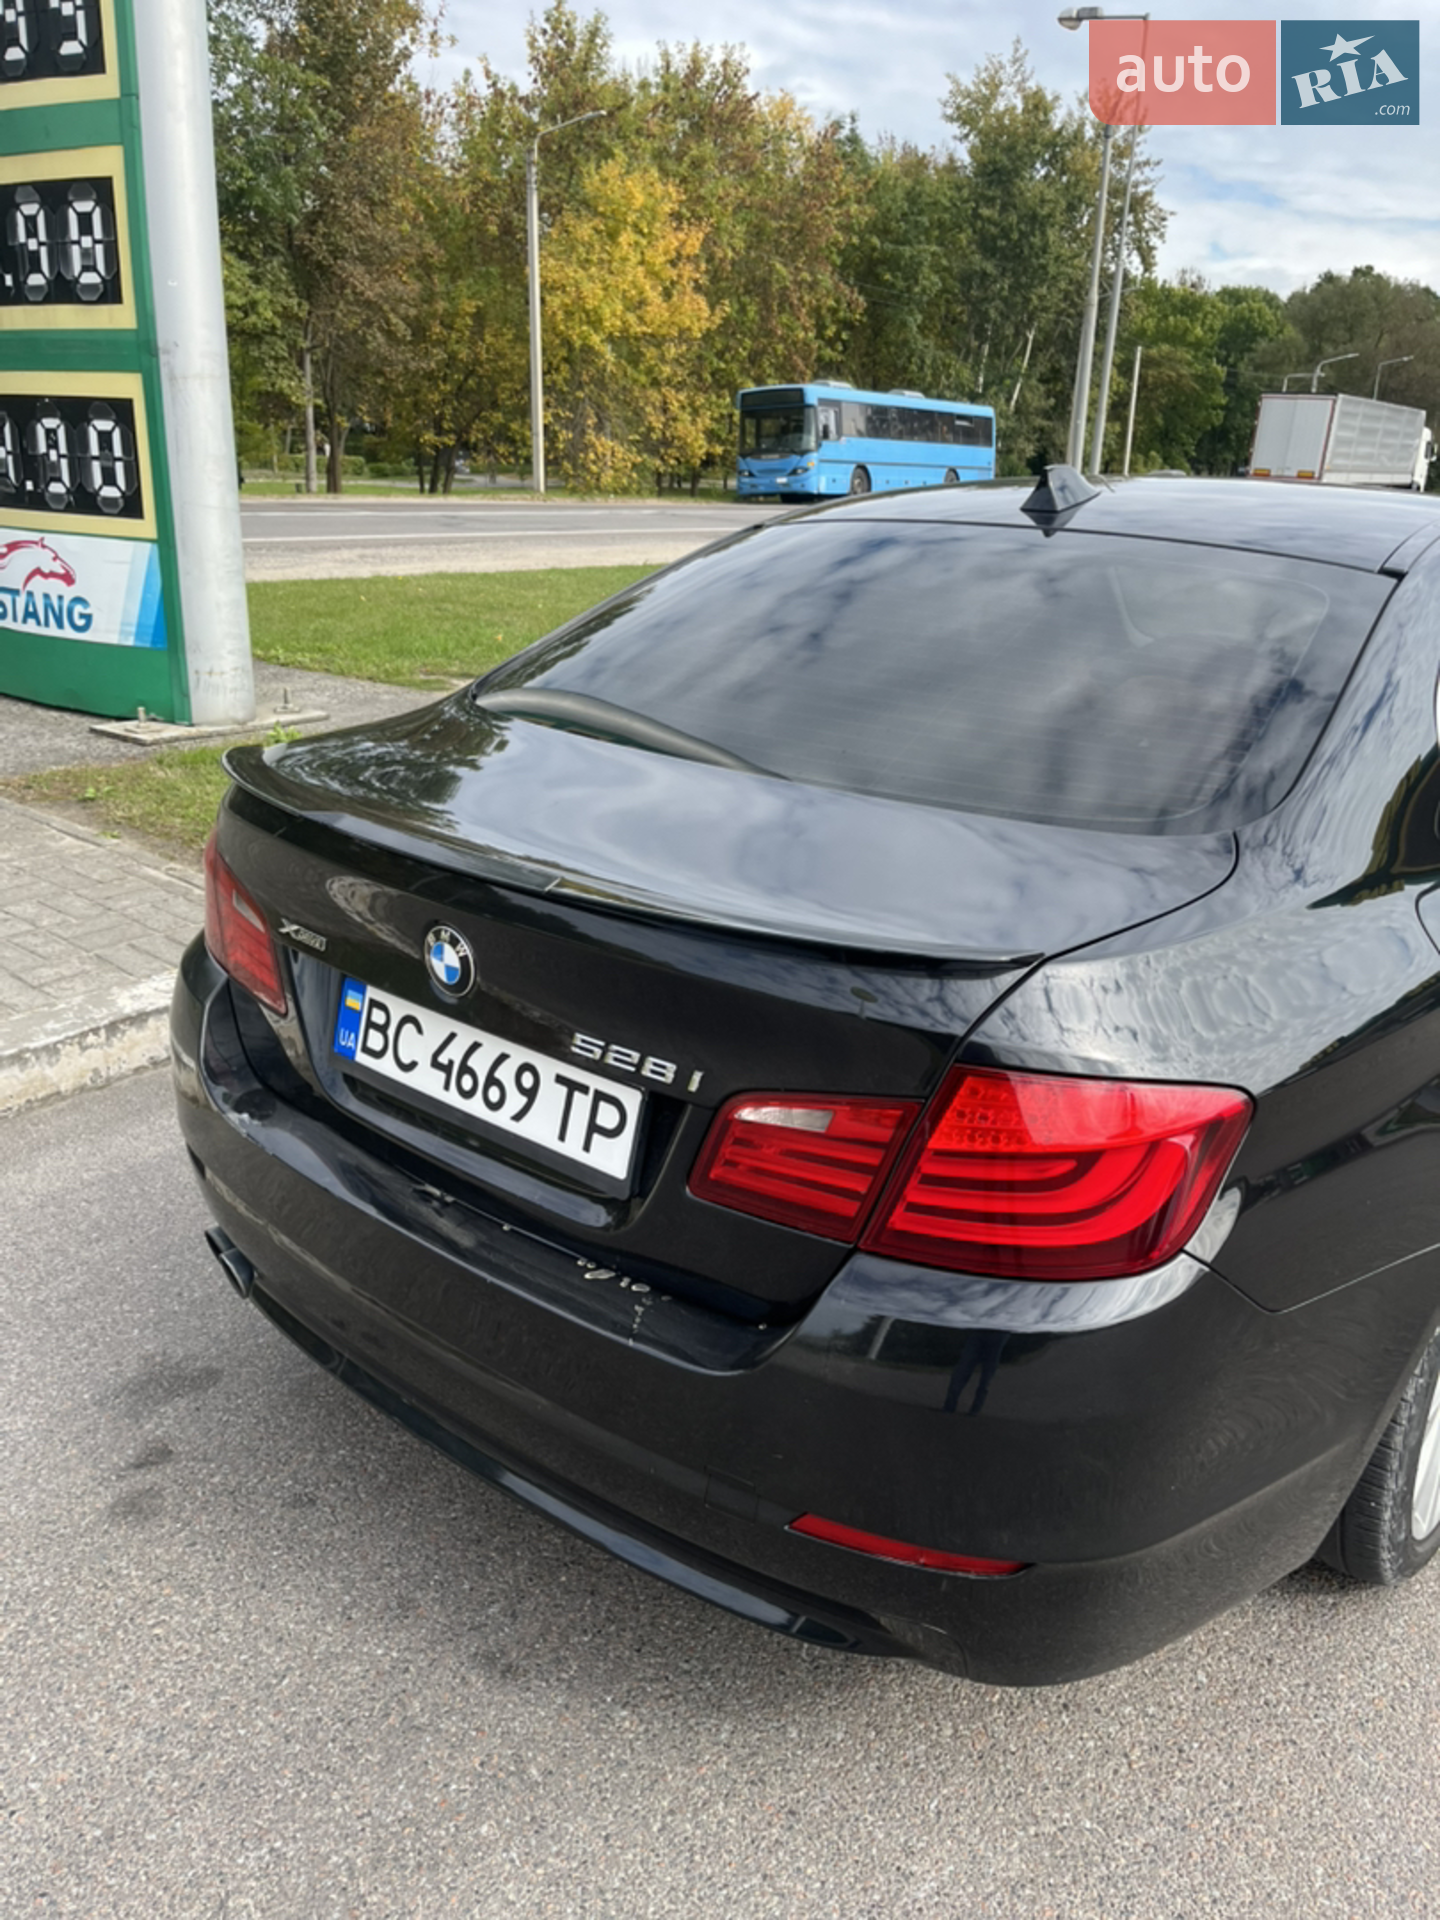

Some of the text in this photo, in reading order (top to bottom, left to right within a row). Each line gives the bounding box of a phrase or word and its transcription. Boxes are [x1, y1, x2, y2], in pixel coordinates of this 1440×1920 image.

[339, 1027, 357, 1051] UA
[360, 997, 628, 1154] BC 4669 TP
